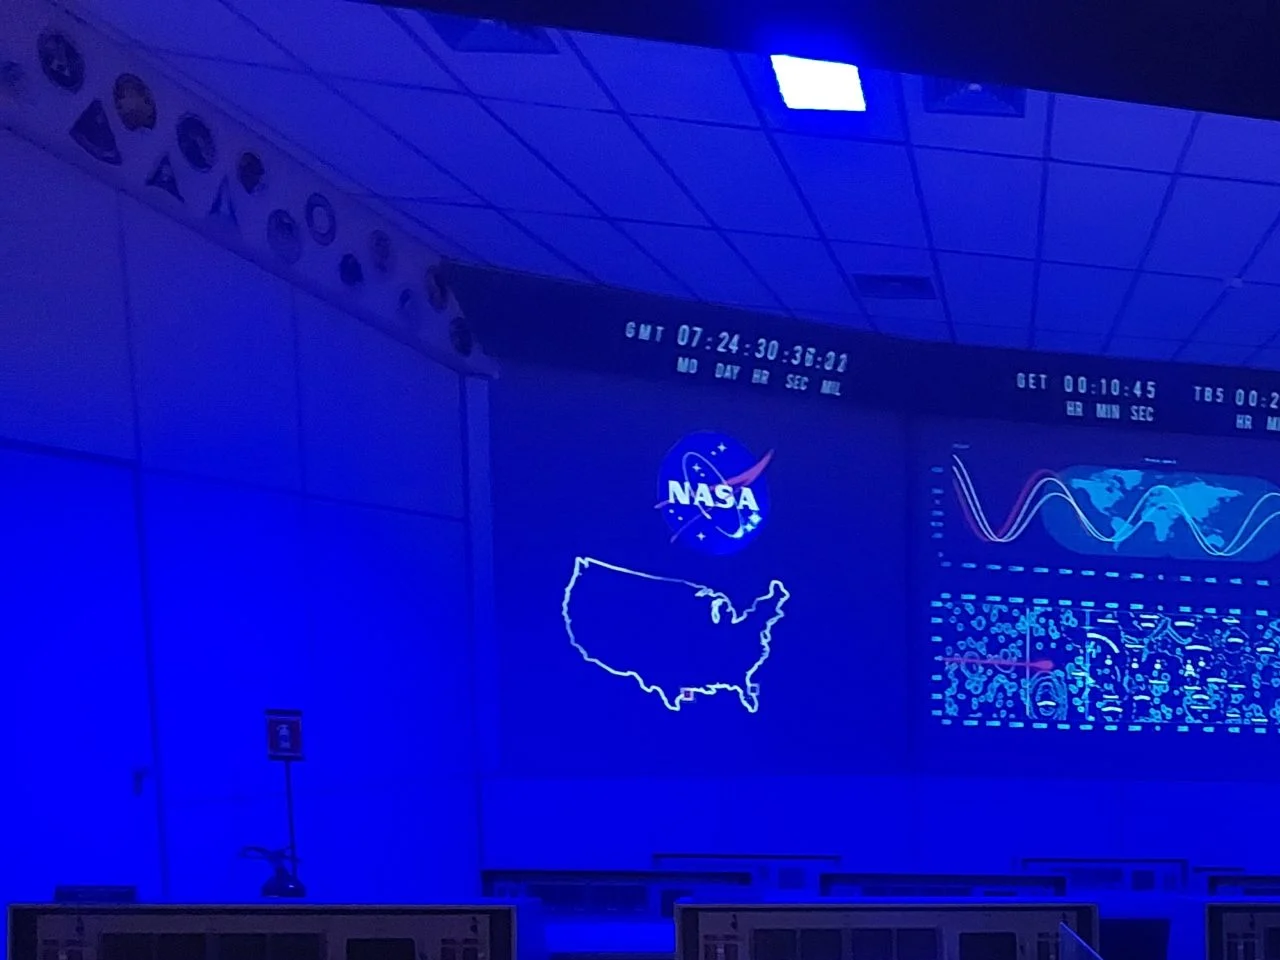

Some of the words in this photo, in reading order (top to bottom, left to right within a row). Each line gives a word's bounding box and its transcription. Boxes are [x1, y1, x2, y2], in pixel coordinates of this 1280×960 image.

[625, 321, 664, 342] GMT
[676, 356, 698, 374] MO
[714, 362, 741, 381] DAY
[751, 368, 770, 385] HR
[785, 373, 809, 391] SEC
[1016, 372, 1048, 390] GET
[1063, 375, 1156, 399] 00:10:45
[1066, 401, 1083, 417] HR
[1096, 403, 1120, 420] MIN
[1130, 405, 1155, 422] SEC
[1236, 414, 1252, 430] HR
[668, 480, 760, 511] NASA
